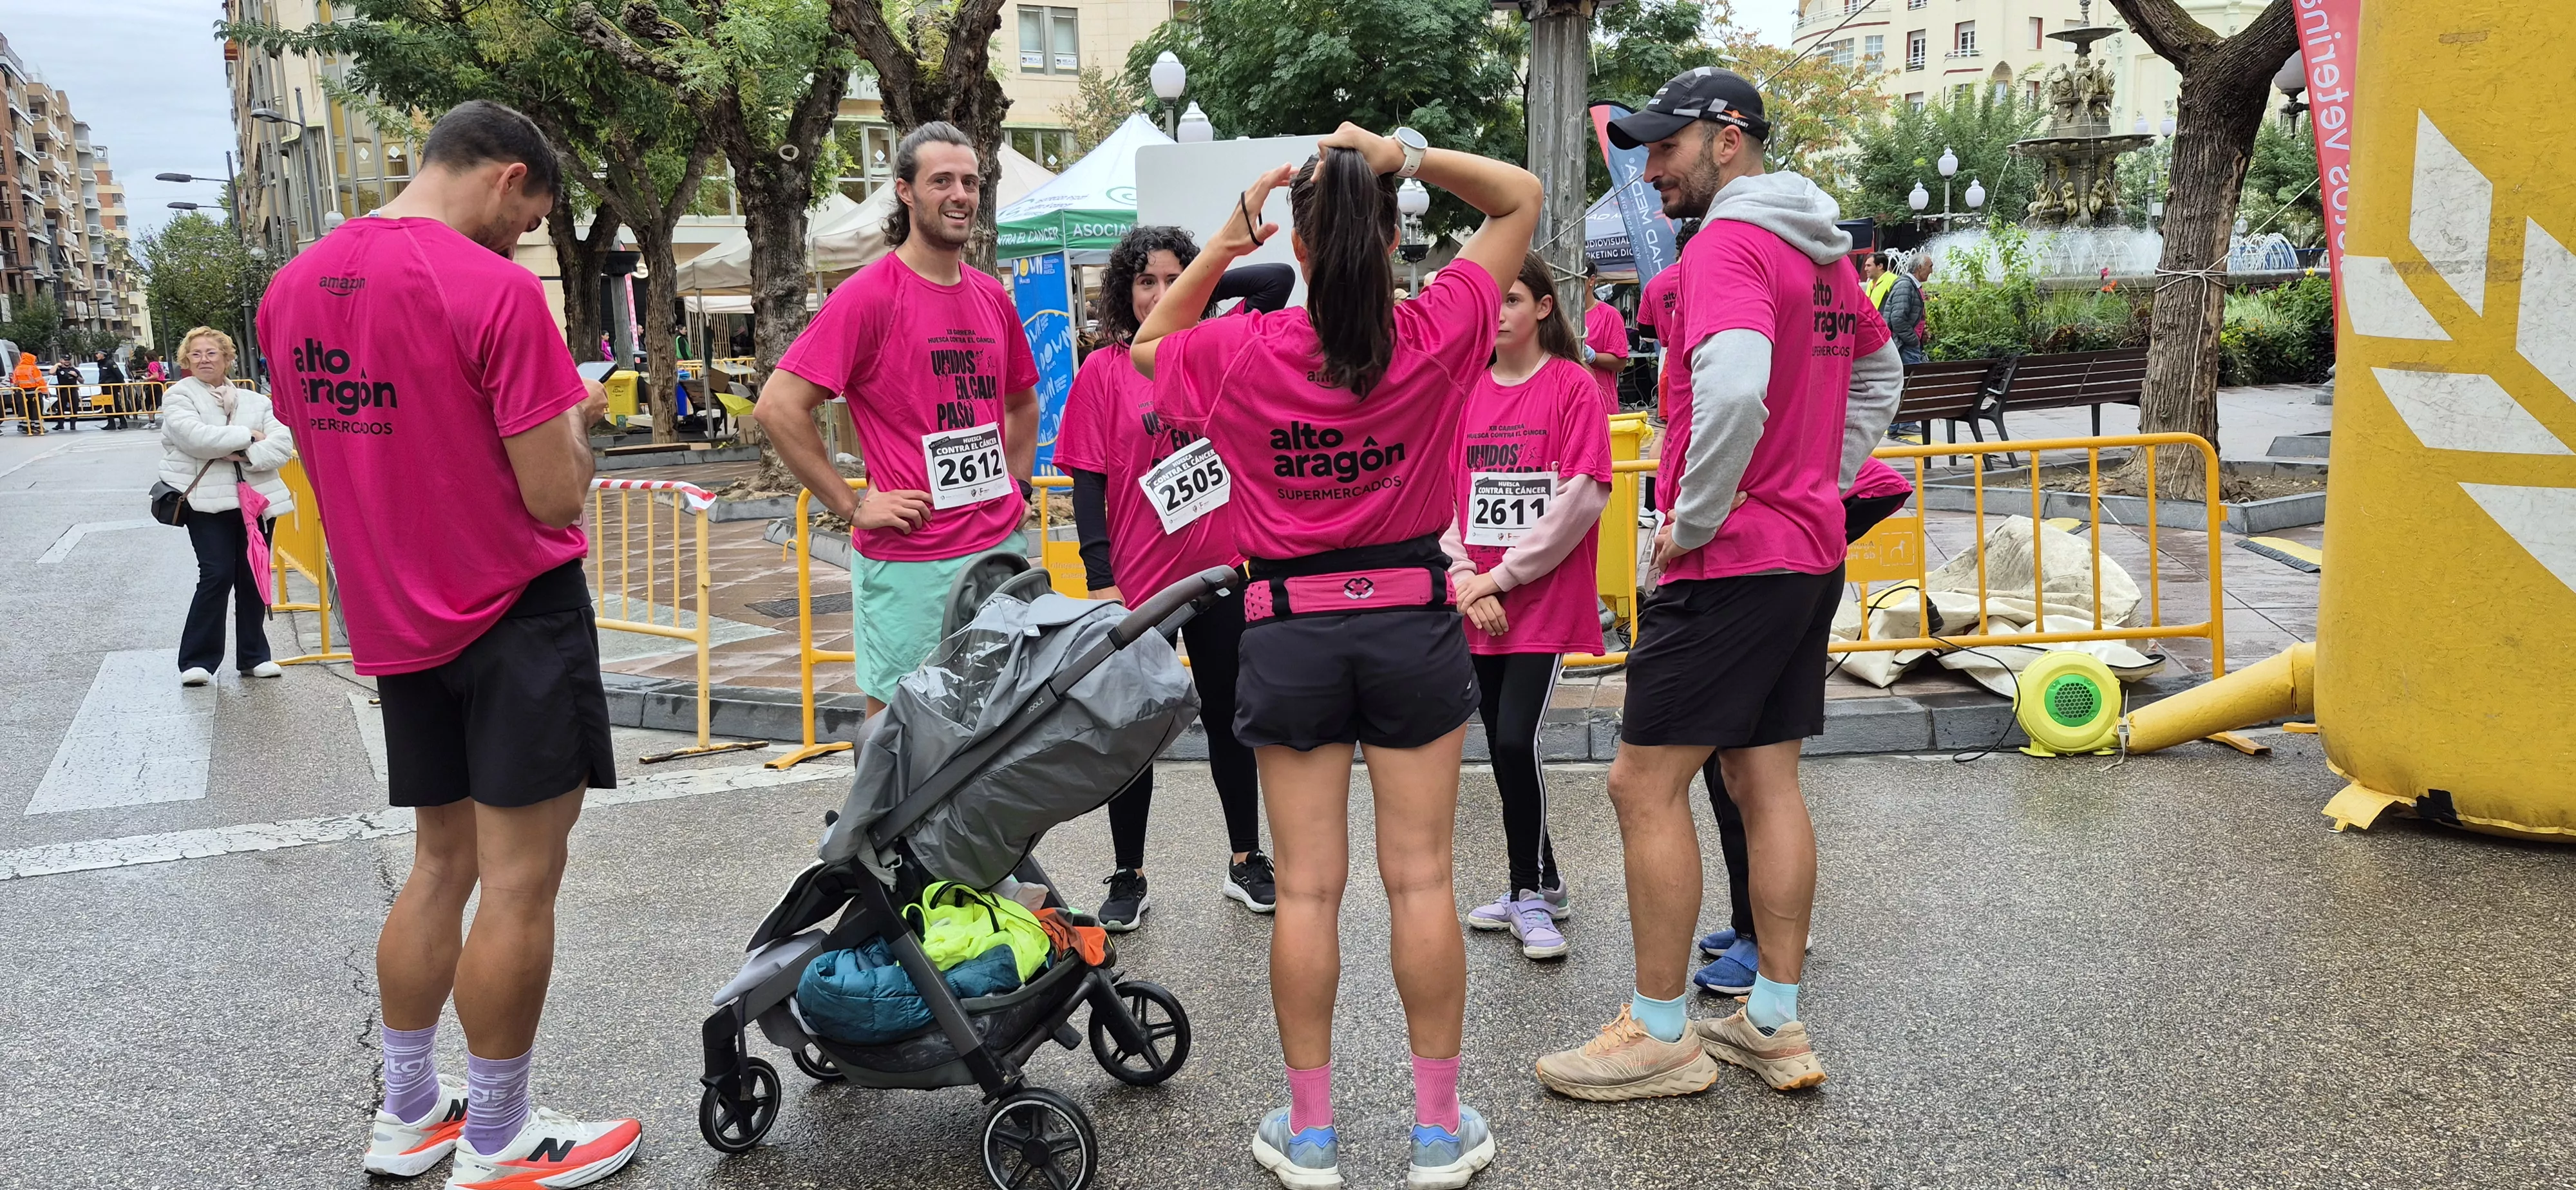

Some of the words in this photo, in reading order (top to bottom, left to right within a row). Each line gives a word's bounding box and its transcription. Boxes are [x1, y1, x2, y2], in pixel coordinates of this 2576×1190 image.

[1716, 114, 1749, 128] ANNIVERSARY
[1017, 232, 1026, 244] EL
[1028, 227, 1059, 242] CÁNCER
[1013, 255, 1043, 277] DOWN
[1812, 276, 1832, 307] alto
[294, 338, 350, 374] alto
[931, 350, 976, 376] UNIDOS
[955, 375, 968, 400] EN
[937, 401, 975, 431] PASO
[1499, 423, 1525, 431] CARRERA
[936, 444, 970, 455] CONTRA
[979, 437, 997, 448] CÁNCER
[963, 435, 982, 444] HUESCA
[1270, 420, 1343, 451] alto
[937, 449, 1003, 487] 2612
[1153, 466, 1183, 486] CONTRA
[1182, 462, 1191, 470] EL
[1190, 449, 1216, 466] CÁNCER
[1172, 453, 1193, 468] HUESCA
[1466, 443, 1519, 469] UNIDOS
[1159, 458, 1224, 512] 2505
[1278, 475, 1402, 501] SUPERMERCADOS
[1515, 486, 1546, 495] CÁNCER
[1475, 498, 1544, 525] 2611
[1027, 697, 1045, 715] JOOLZ
[526, 1137, 578, 1162] N
